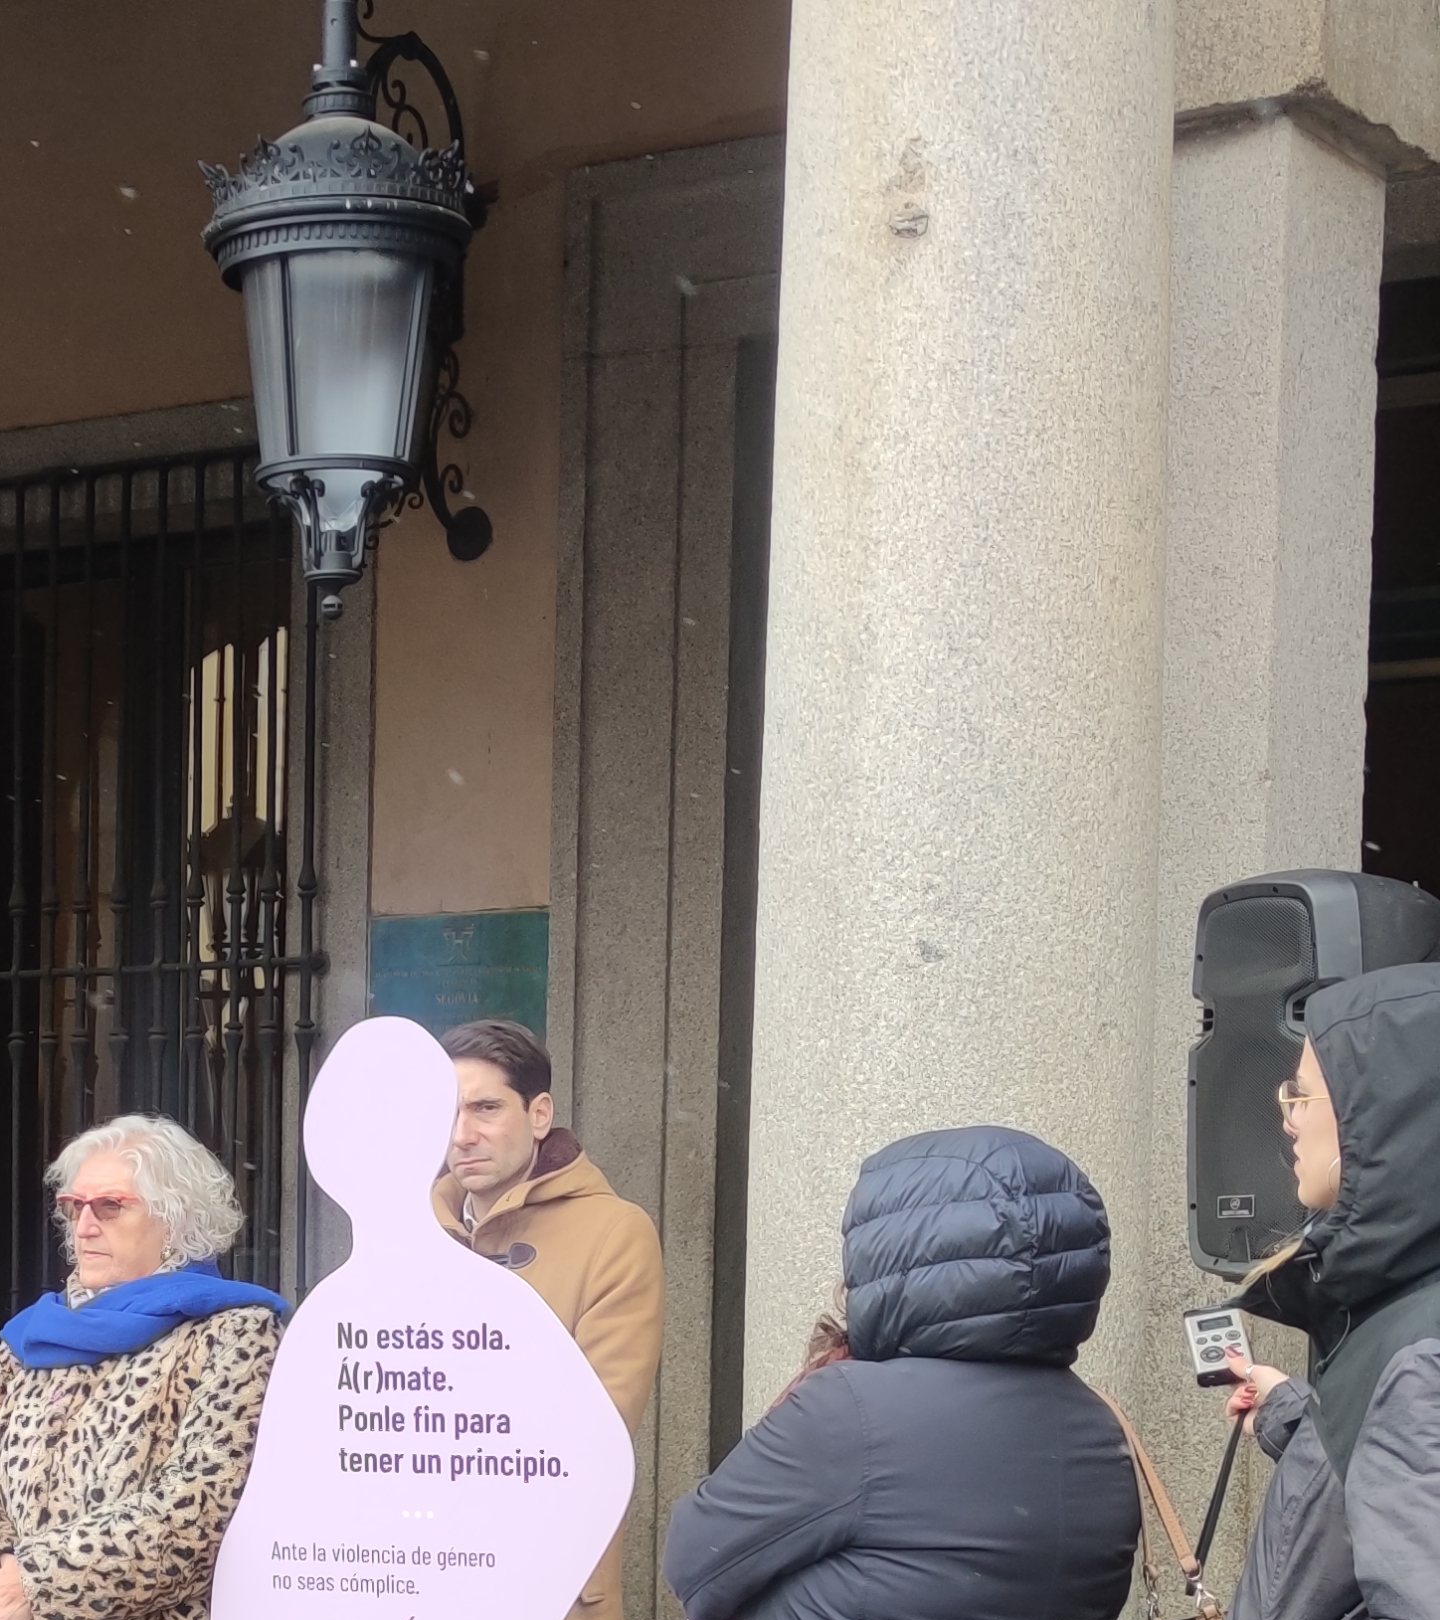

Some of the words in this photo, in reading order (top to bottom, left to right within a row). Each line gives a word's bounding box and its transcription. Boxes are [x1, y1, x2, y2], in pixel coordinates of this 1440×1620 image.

[338, 1322, 368, 1350] No
[377, 1322, 444, 1350] estás
[452, 1323, 511, 1351] sola.
[337, 1356, 454, 1394] Á(r)mate.
[338, 1404, 406, 1433] Ponle
[413, 1405, 446, 1433] fin
[454, 1412, 511, 1441] para
[338, 1447, 405, 1474] tener
[412, 1454, 442, 1475] un
[450, 1448, 569, 1483] principio.
[271, 1541, 308, 1562] Ante
[312, 1543, 327, 1562] la
[332, 1543, 406, 1565] violencia
[411, 1545, 432, 1566] de
[437, 1546, 496, 1571] género
[272, 1574, 292, 1590] no
[297, 1575, 335, 1592] seas
[340, 1573, 420, 1598] cómplice.
